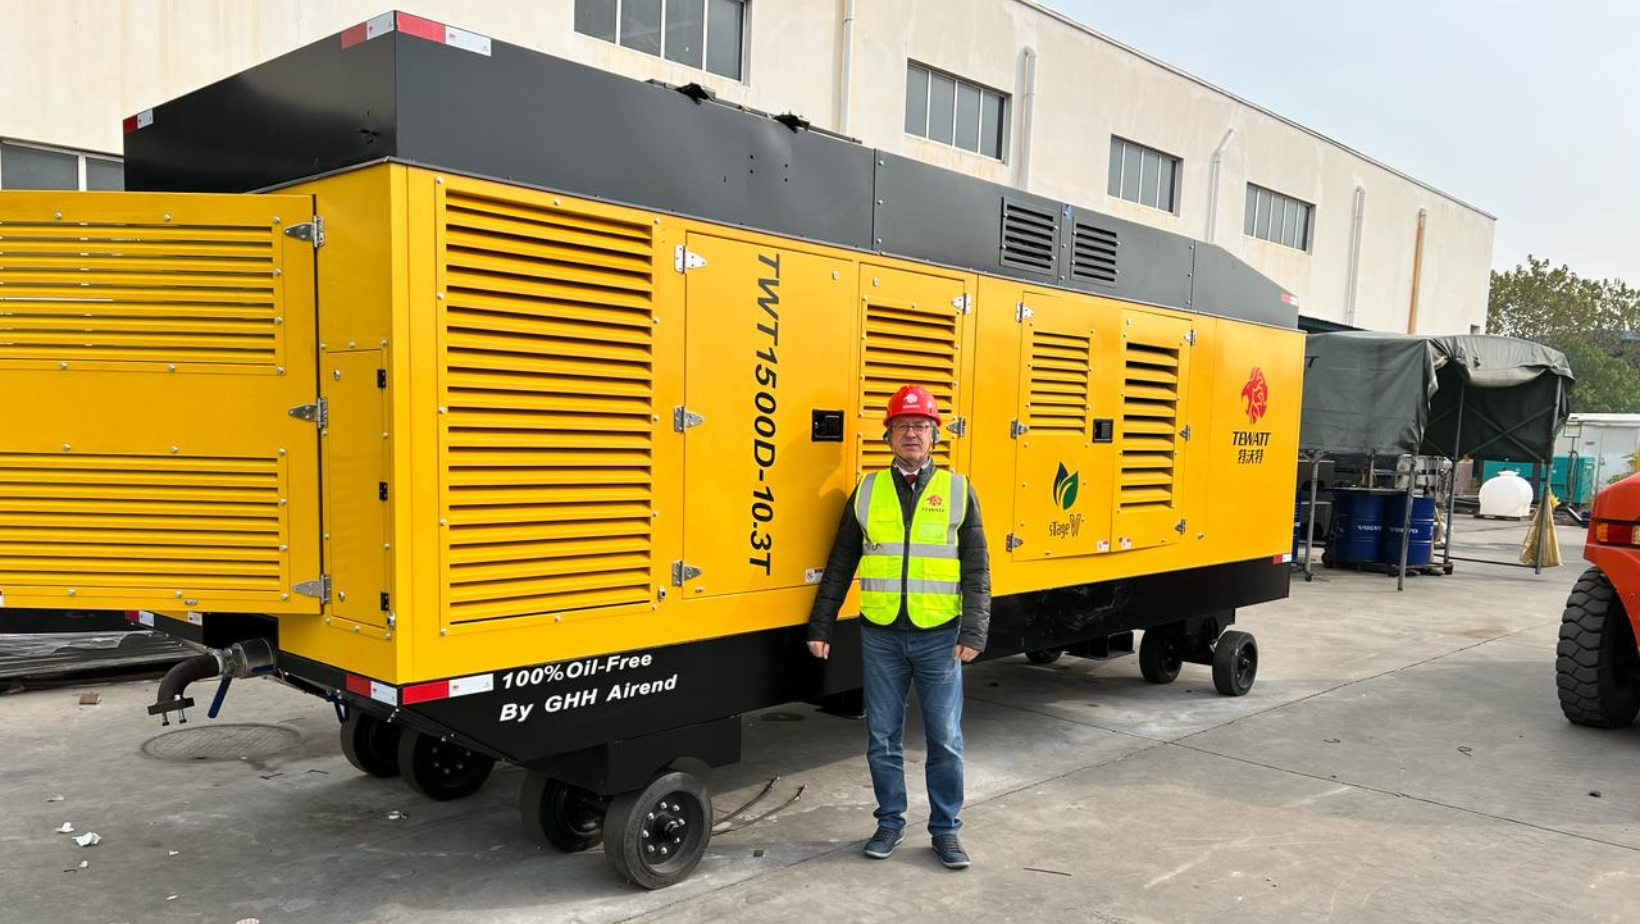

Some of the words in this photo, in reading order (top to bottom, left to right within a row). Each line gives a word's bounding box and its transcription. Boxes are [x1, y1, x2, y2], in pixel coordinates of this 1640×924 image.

[749, 252, 781, 576] TWT1500D-10.3T
[1232, 431, 1271, 446] TEWATT
[1238, 449, 1264, 464] 特沃特
[499, 703, 534, 723] By
[544, 688, 599, 713] GHH
[605, 674, 678, 702] Airend
